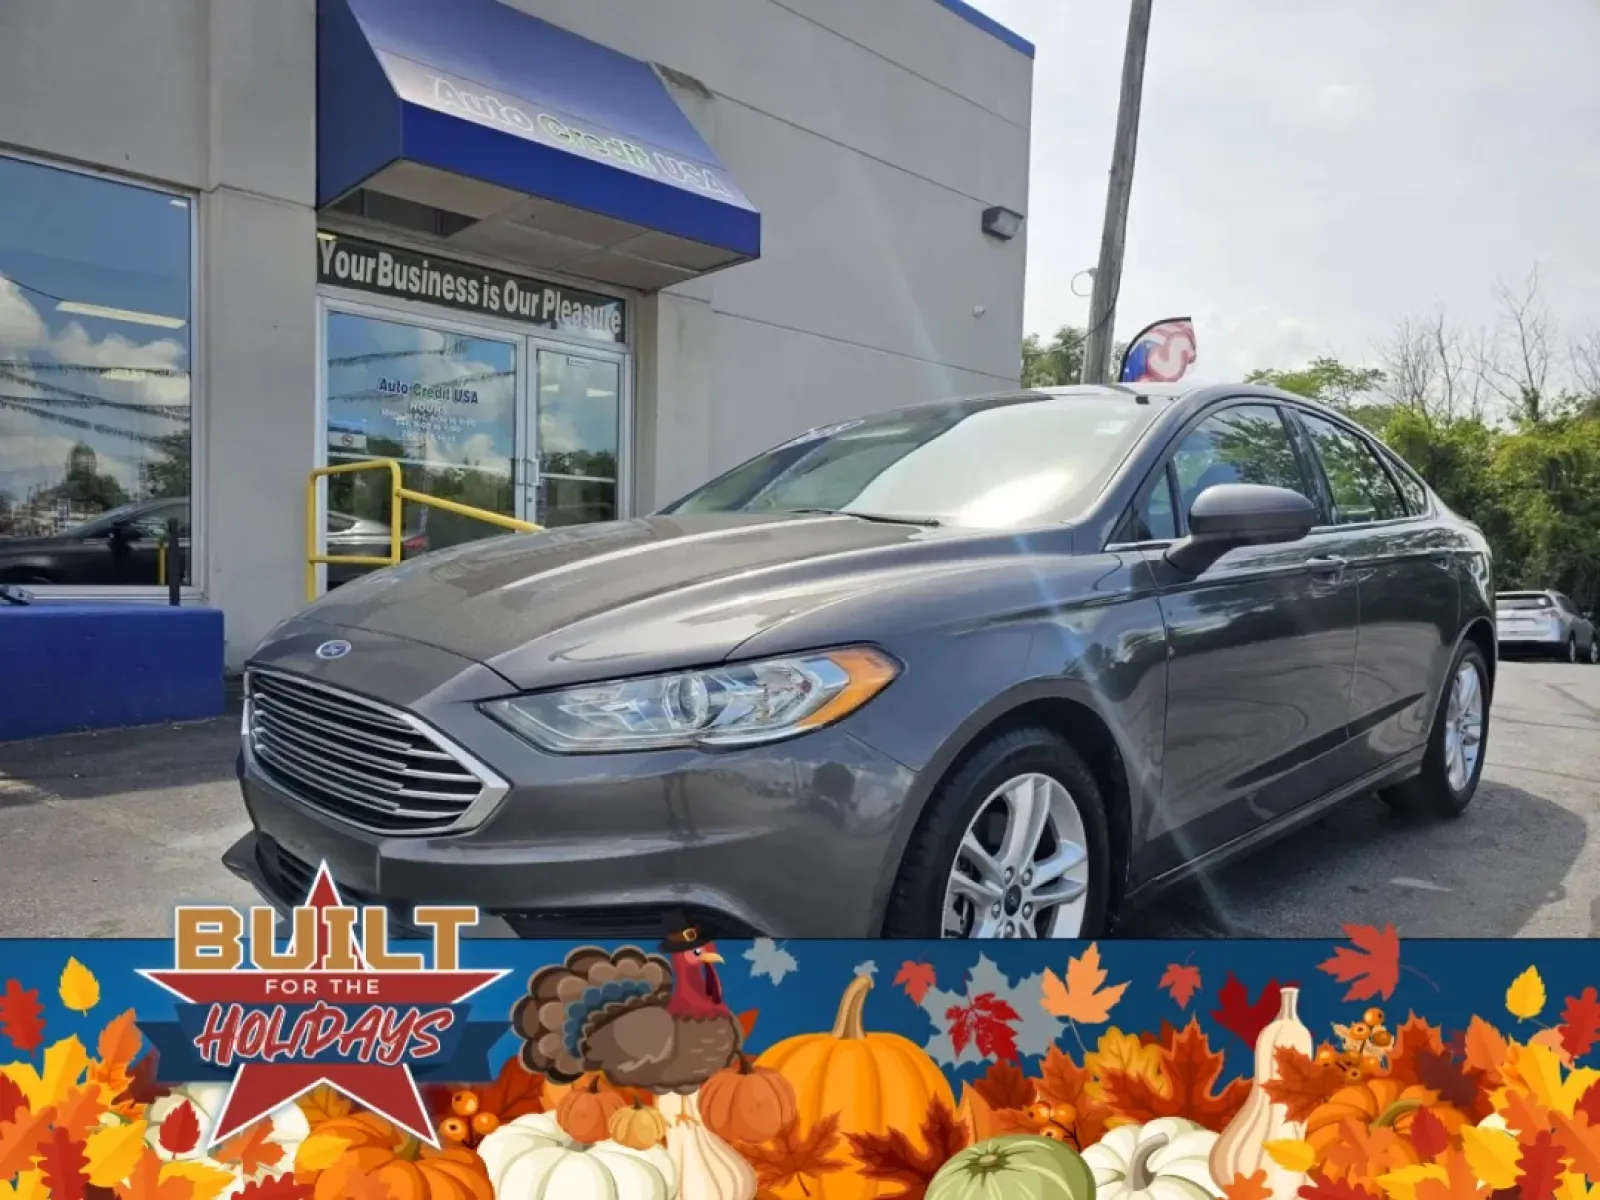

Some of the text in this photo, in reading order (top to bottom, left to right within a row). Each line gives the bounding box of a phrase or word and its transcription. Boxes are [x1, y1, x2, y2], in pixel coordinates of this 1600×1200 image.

[427, 74, 733, 198] Auto Credit USA
[319, 238, 622, 334] Your Business is Our Pleasure
[378, 377, 478, 404] Auto Credit USA
